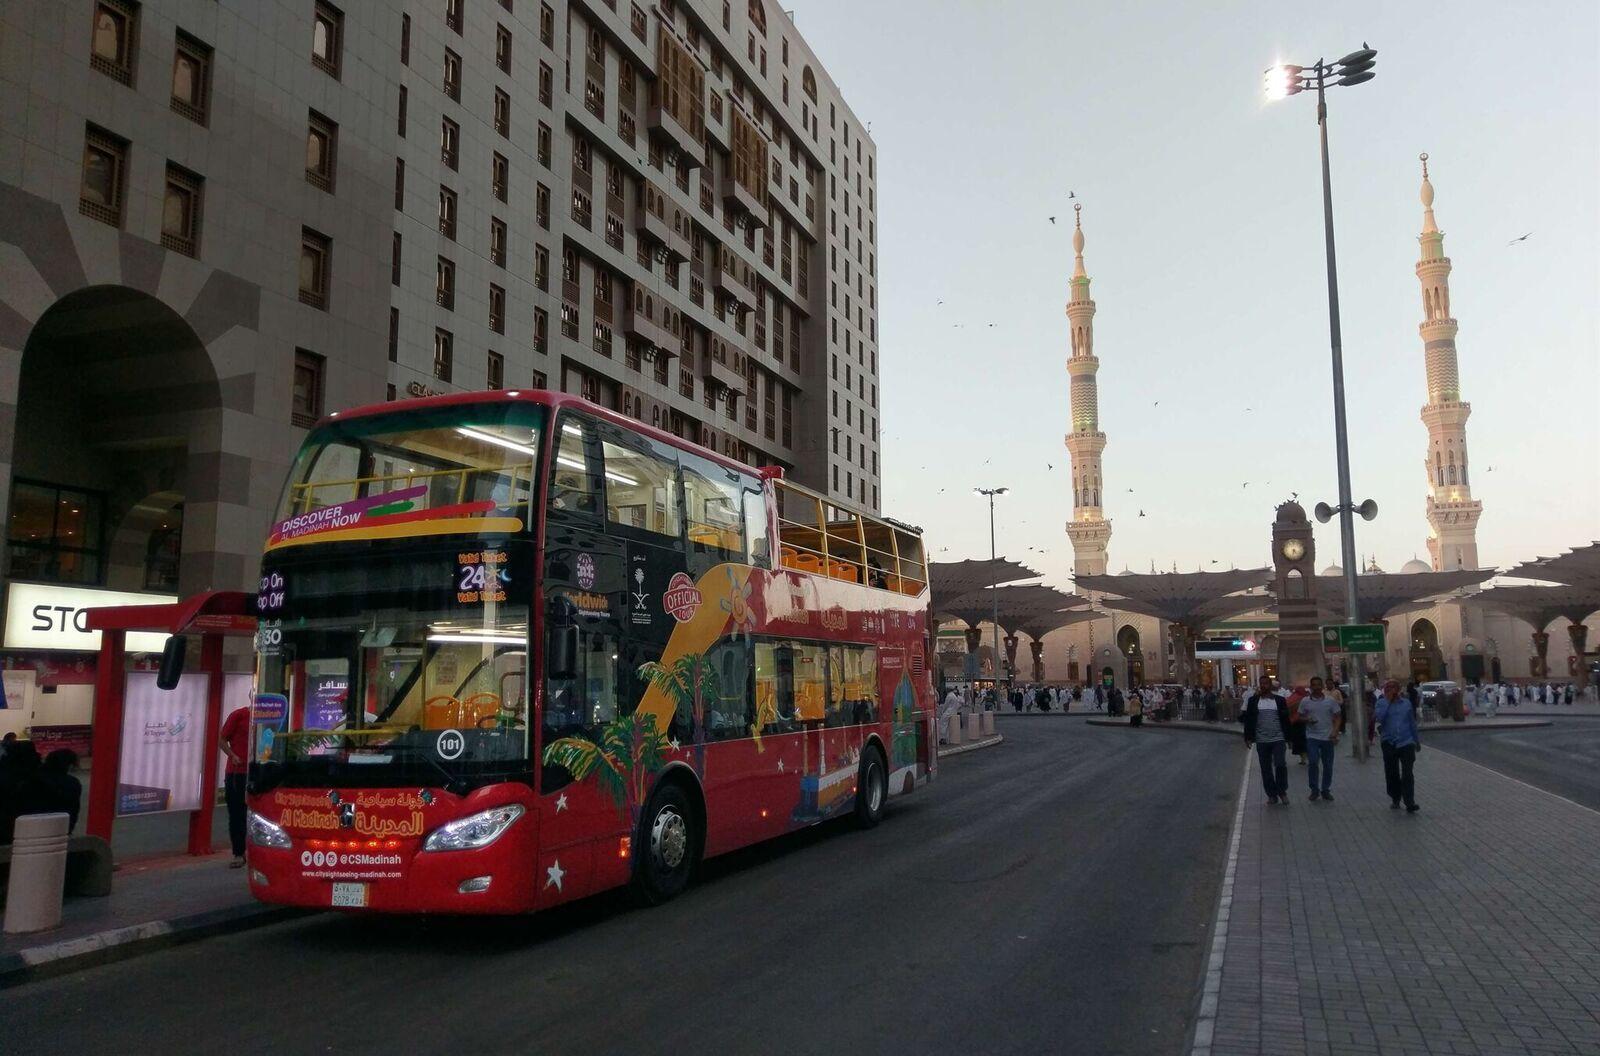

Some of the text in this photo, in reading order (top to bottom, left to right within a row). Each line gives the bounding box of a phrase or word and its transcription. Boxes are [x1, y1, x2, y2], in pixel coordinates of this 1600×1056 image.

[281, 511, 361, 541] AL MADINAH NOW
[282, 506, 342, 533] DISCOVER
[270, 573, 283, 588] On
[460, 565, 485, 590] 24
[269, 592, 285, 608] Off
[667, 591, 701, 609] OFFICIAL
[677, 606, 694, 620] TOUR
[441, 739, 459, 750] 101
[279, 808, 340, 830] Al Madinah
[355, 812, 423, 838] المدينة
[340, 854, 402, 865] @CSMadinah
[302, 871, 402, 879] www.citysightseeing-madinah.com
